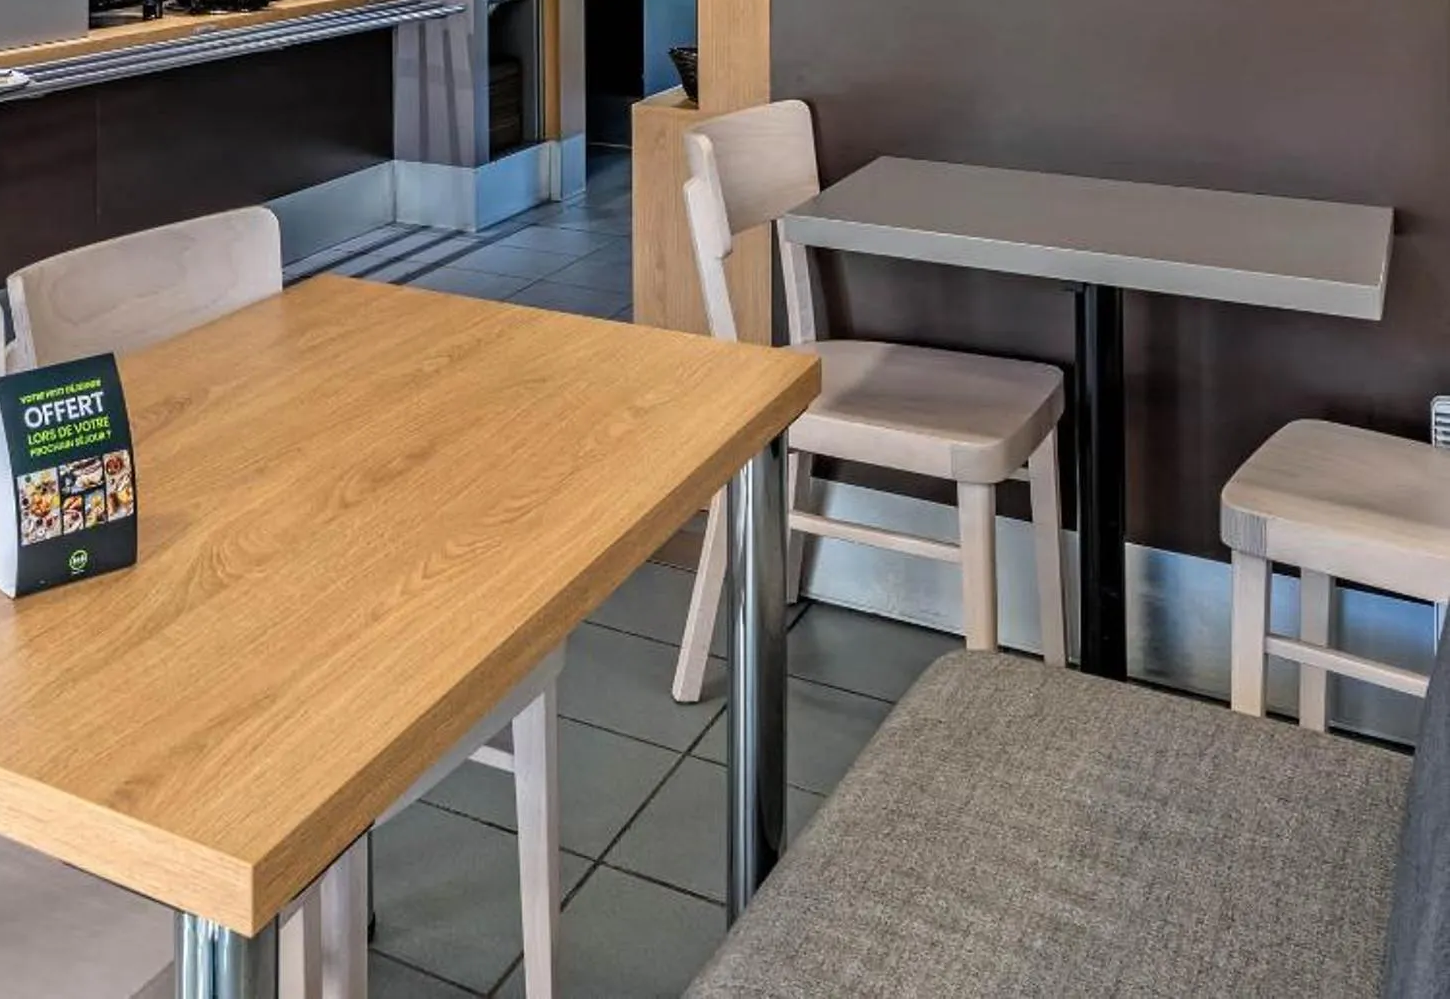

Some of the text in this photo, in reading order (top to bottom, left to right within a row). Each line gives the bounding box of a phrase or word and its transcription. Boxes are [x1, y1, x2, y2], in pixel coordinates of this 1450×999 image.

[24, 391, 104, 428] OFFERT
[27, 416, 110, 445] LORS DE VOTRE
